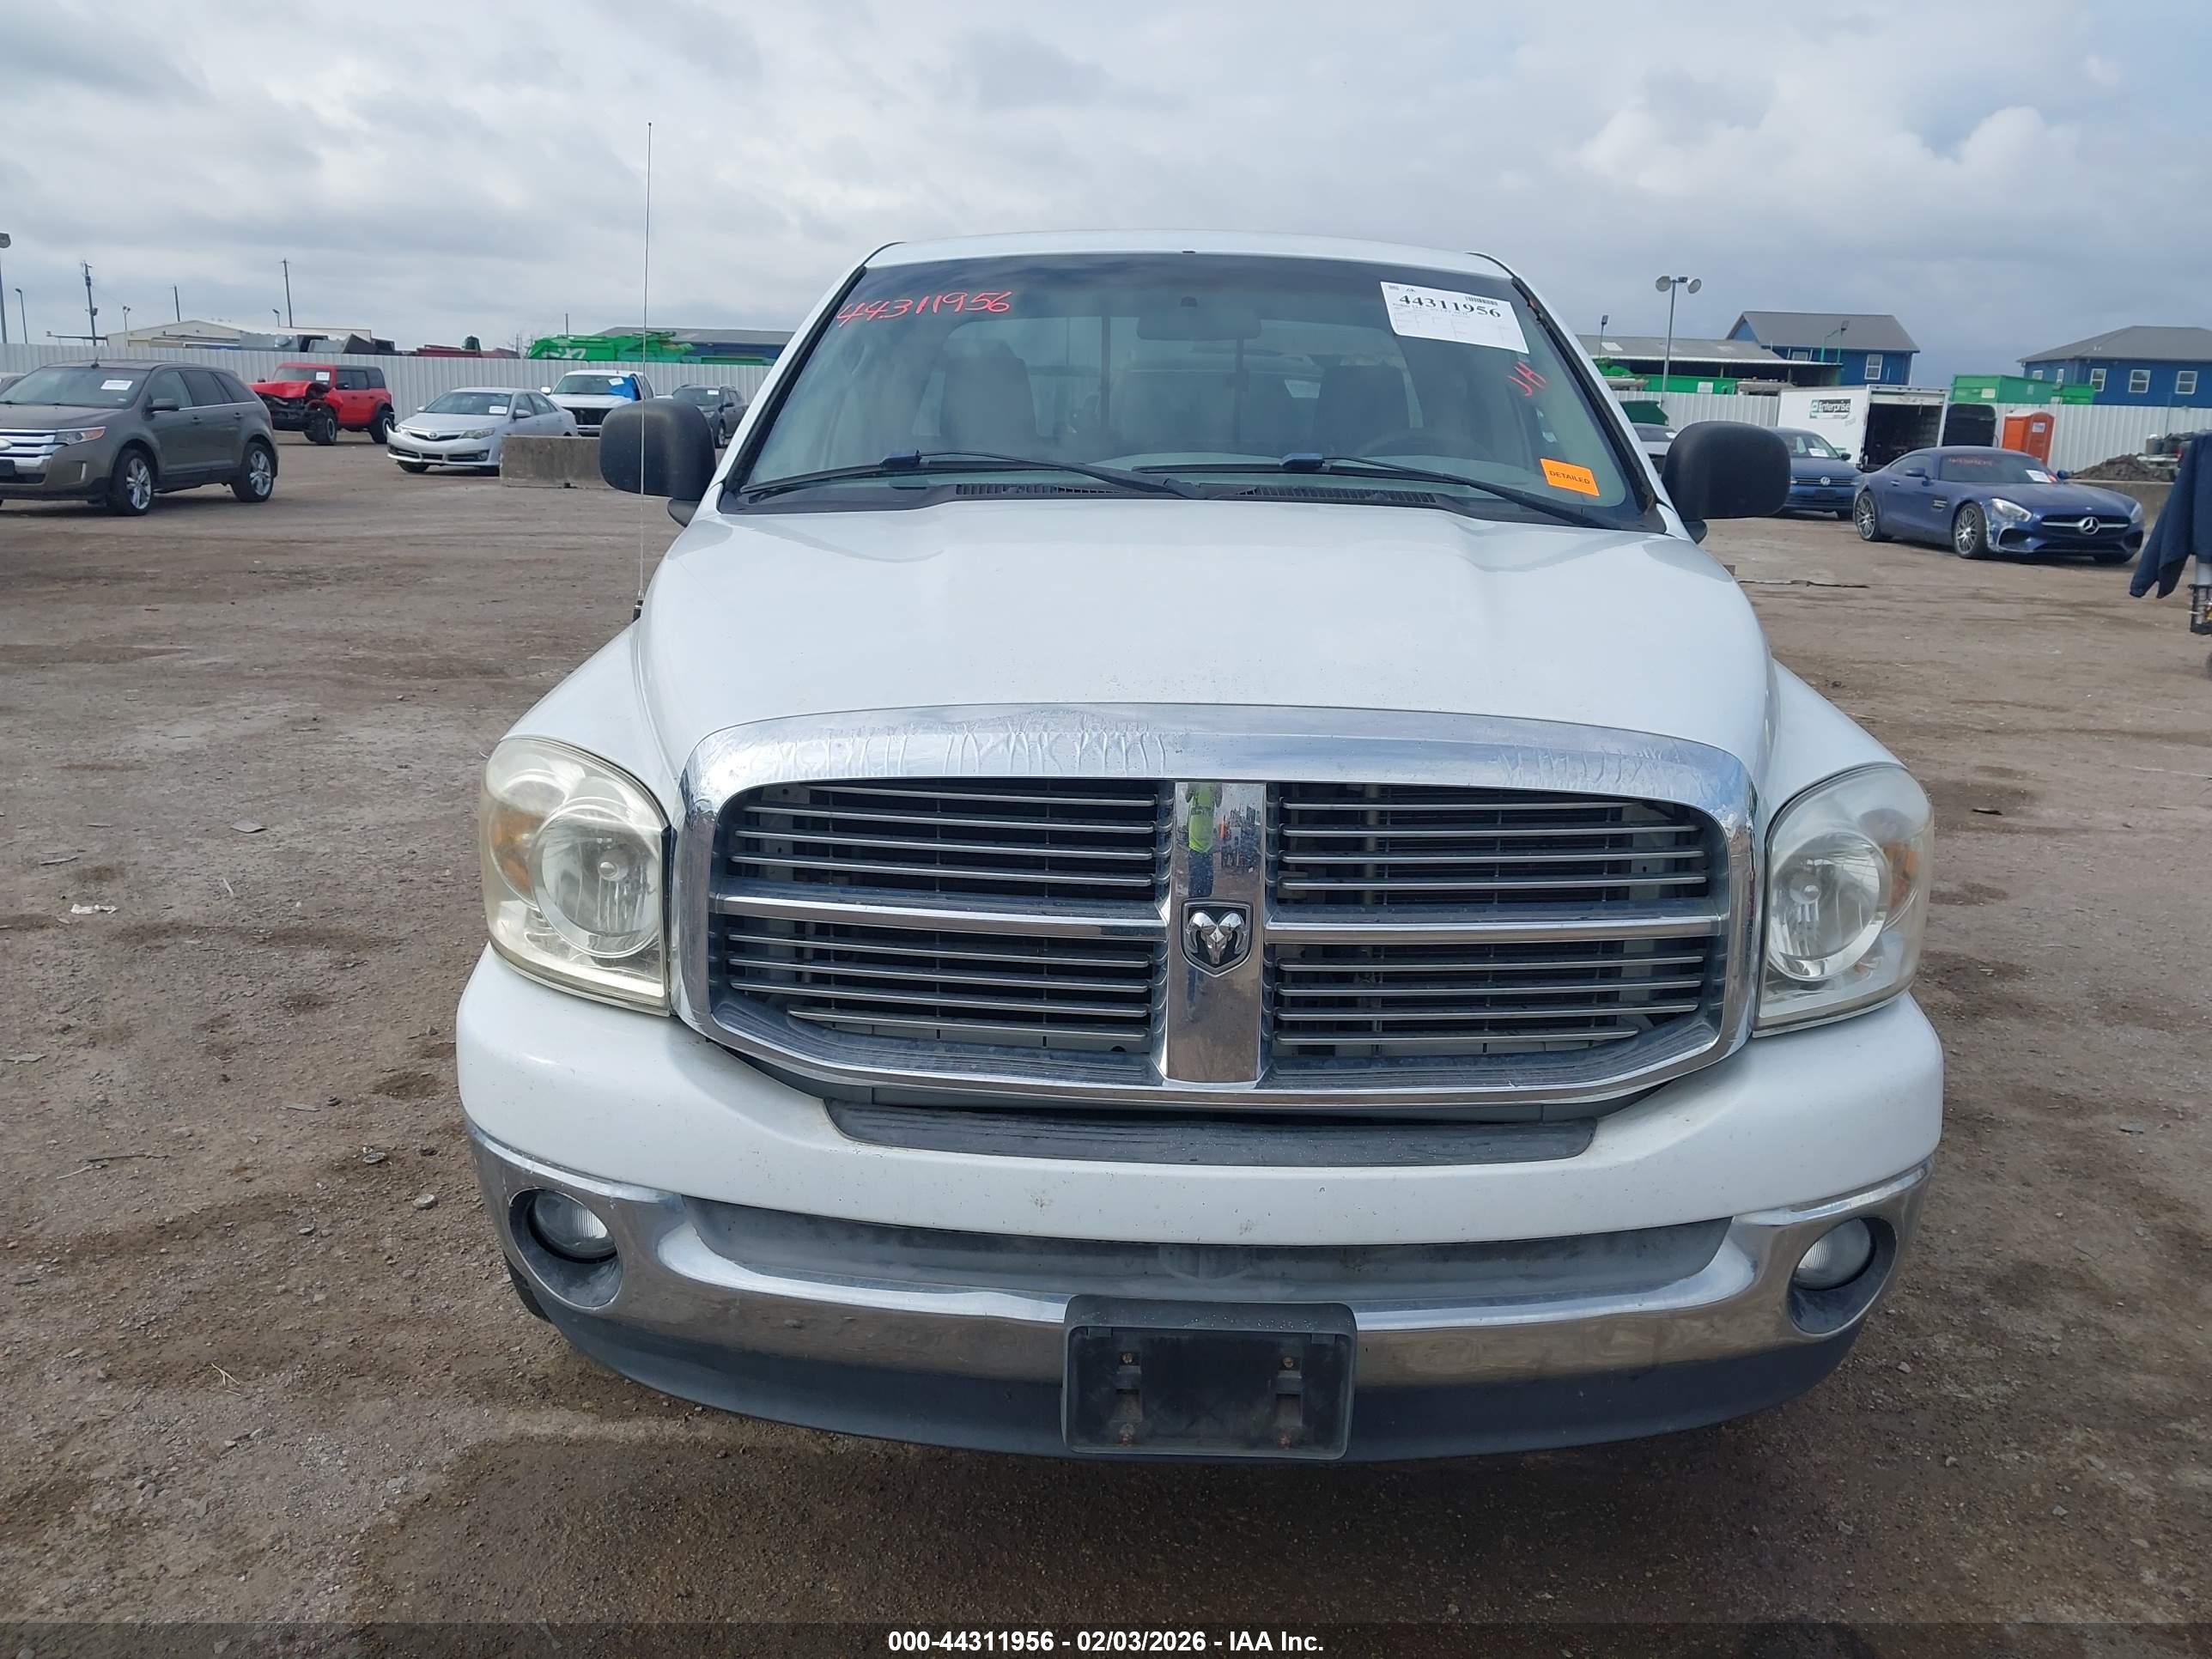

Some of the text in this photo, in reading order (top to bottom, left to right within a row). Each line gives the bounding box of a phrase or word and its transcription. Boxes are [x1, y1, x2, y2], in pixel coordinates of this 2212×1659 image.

[837, 291, 1012, 328] 44311956
[1399, 295, 1502, 319] 44311956
[1819, 401, 1851, 413] Enterprise
[1549, 470, 1590, 484] DETAILED
